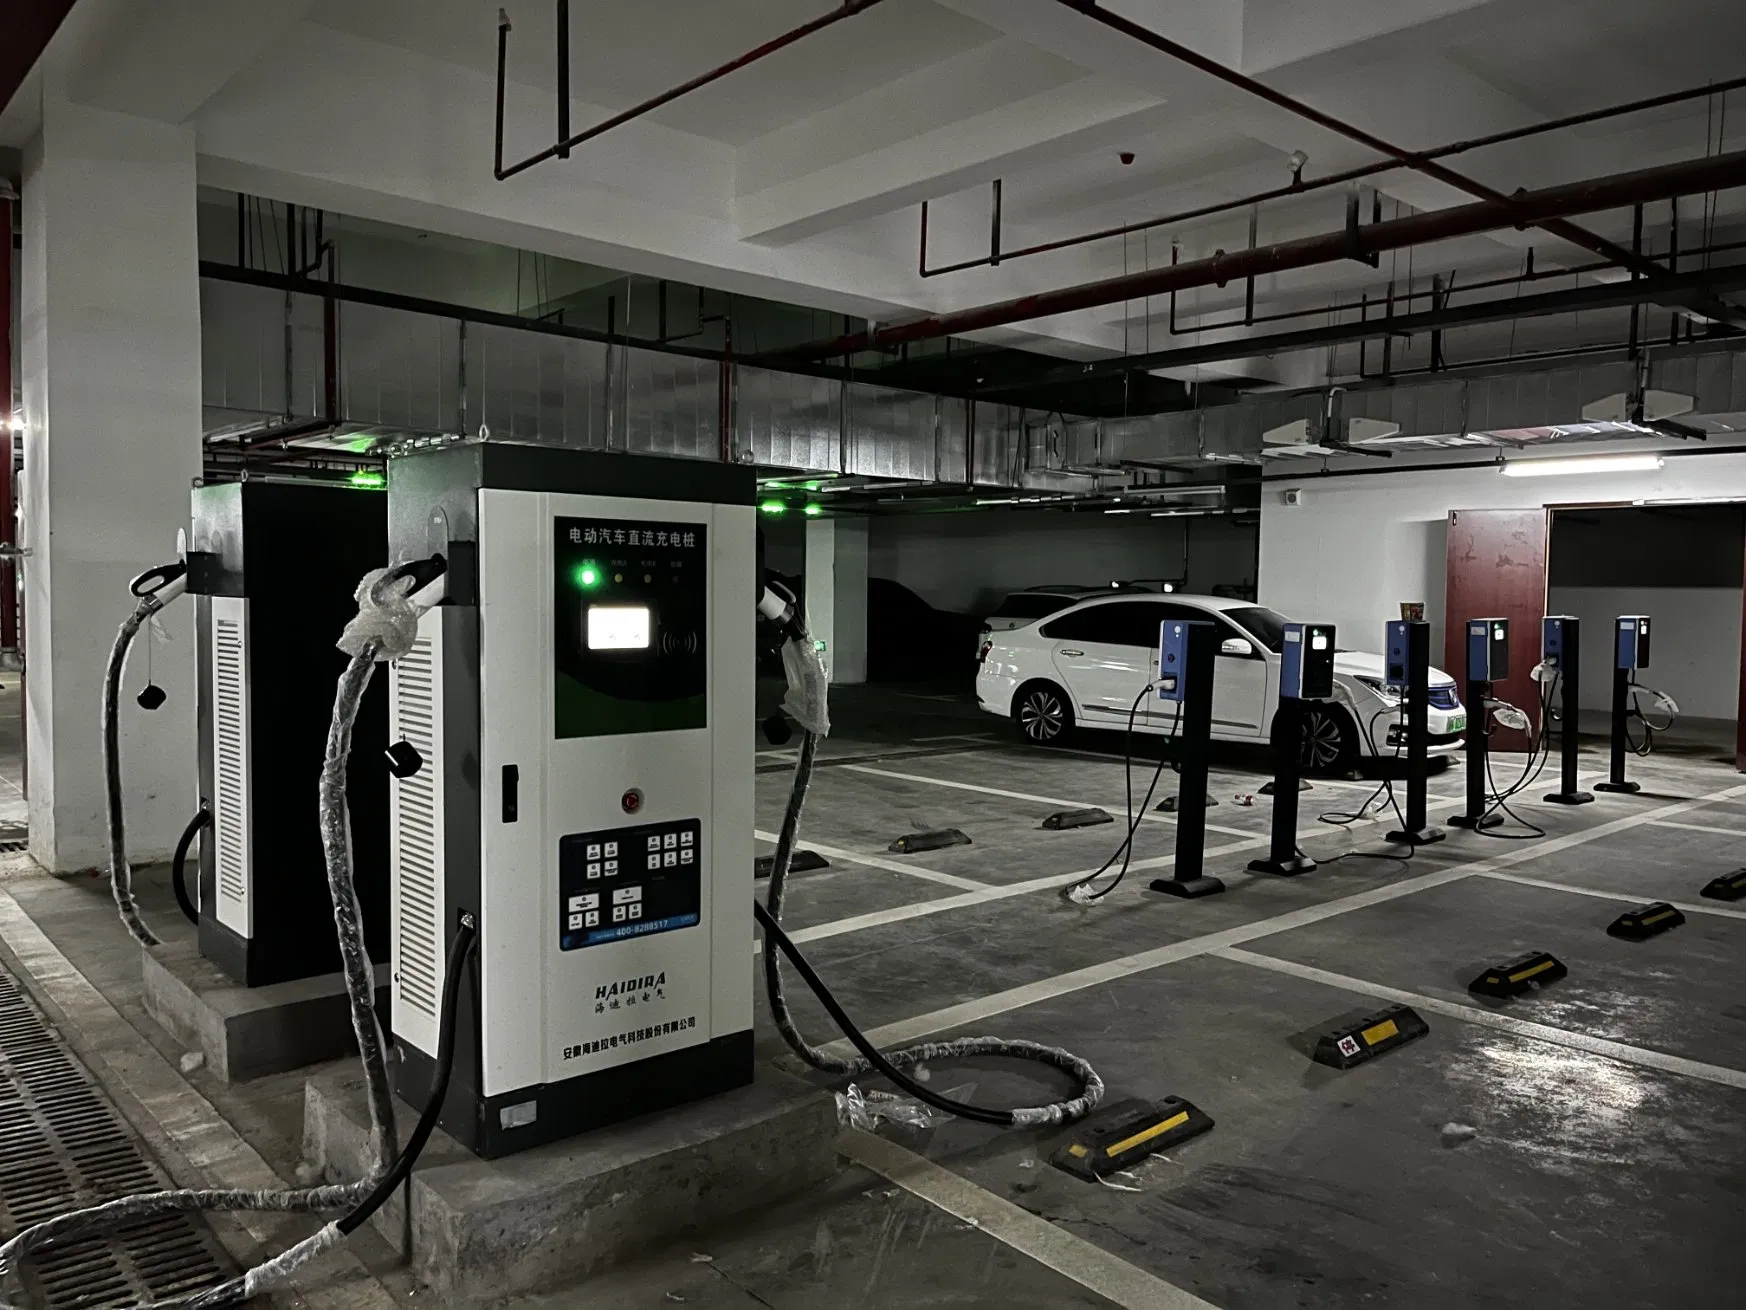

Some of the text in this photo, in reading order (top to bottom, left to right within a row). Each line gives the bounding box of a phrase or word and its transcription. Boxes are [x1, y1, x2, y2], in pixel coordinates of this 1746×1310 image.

[569, 527, 695, 547] 电动汽车直流充电桩
[595, 971, 666, 1001] HAIDIRA
[563, 1016, 696, 1060] 安徽海迪拉电气科技股份有限公司
